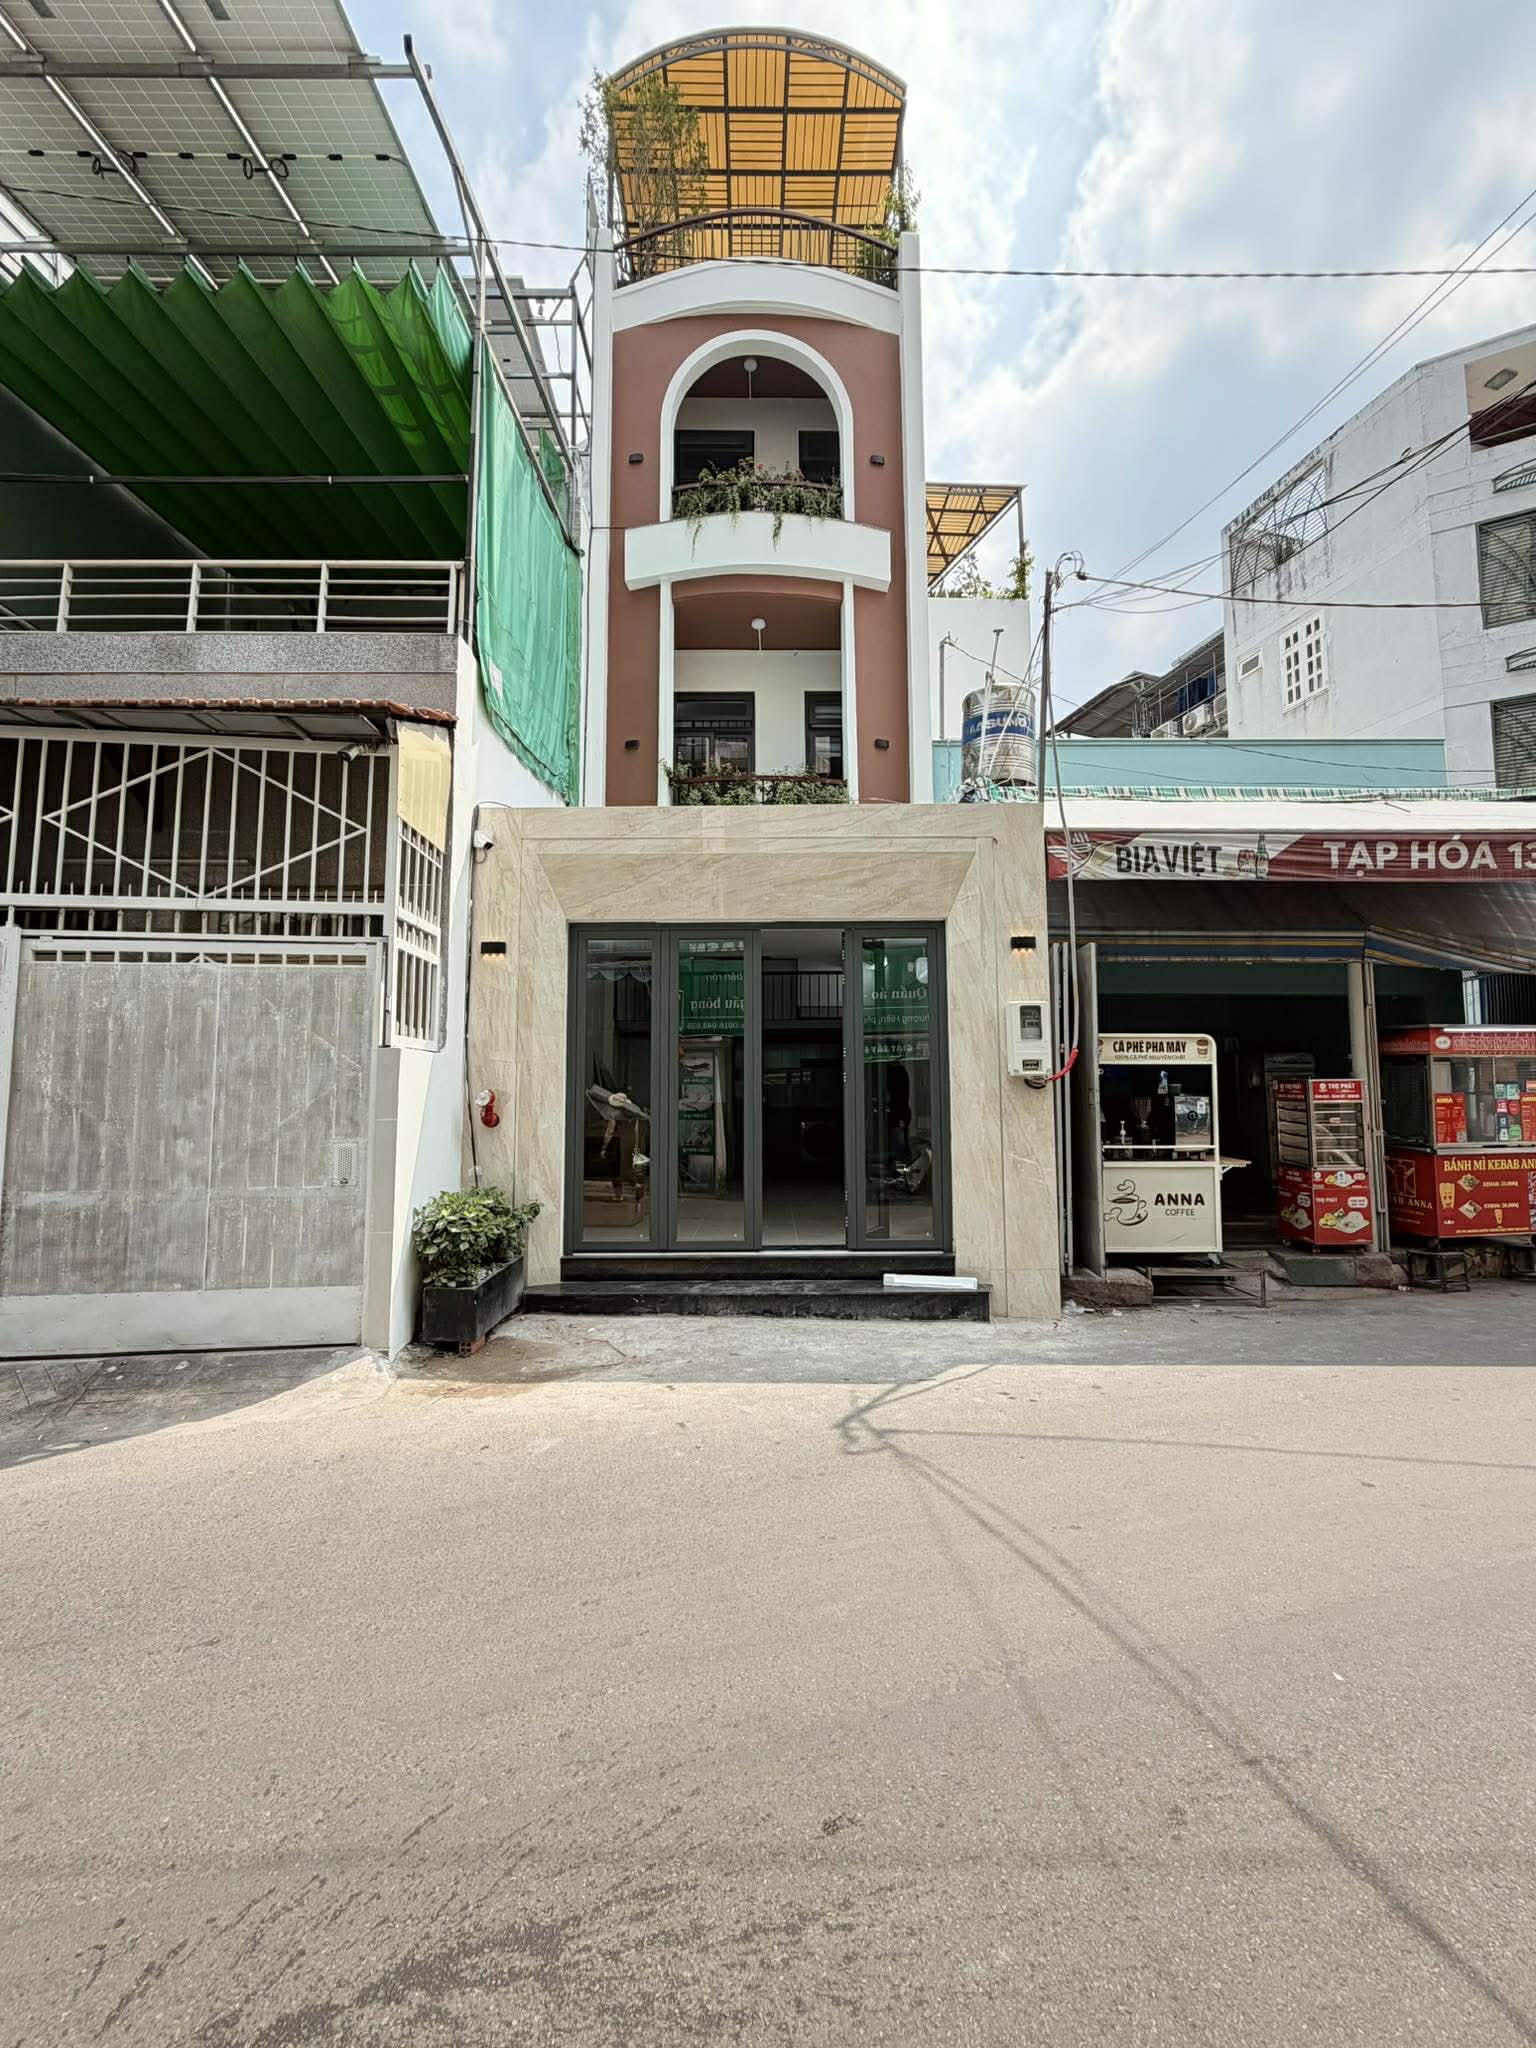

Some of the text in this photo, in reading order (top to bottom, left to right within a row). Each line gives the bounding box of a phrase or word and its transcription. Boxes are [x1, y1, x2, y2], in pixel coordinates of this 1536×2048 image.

[1115, 841, 1222, 877] BIA VIỆT
[1322, 840, 1399, 878] TẠP
[1410, 834, 1498, 870] HÓA
[1443, 1156, 1472, 1172] BÁNH
[1473, 1155, 1486, 1171] MÌ
[1488, 1158, 1520, 1171] KEBAB
[1155, 1193, 1205, 1206] ANNA
[1165, 1208, 1195, 1216] COFFEE
